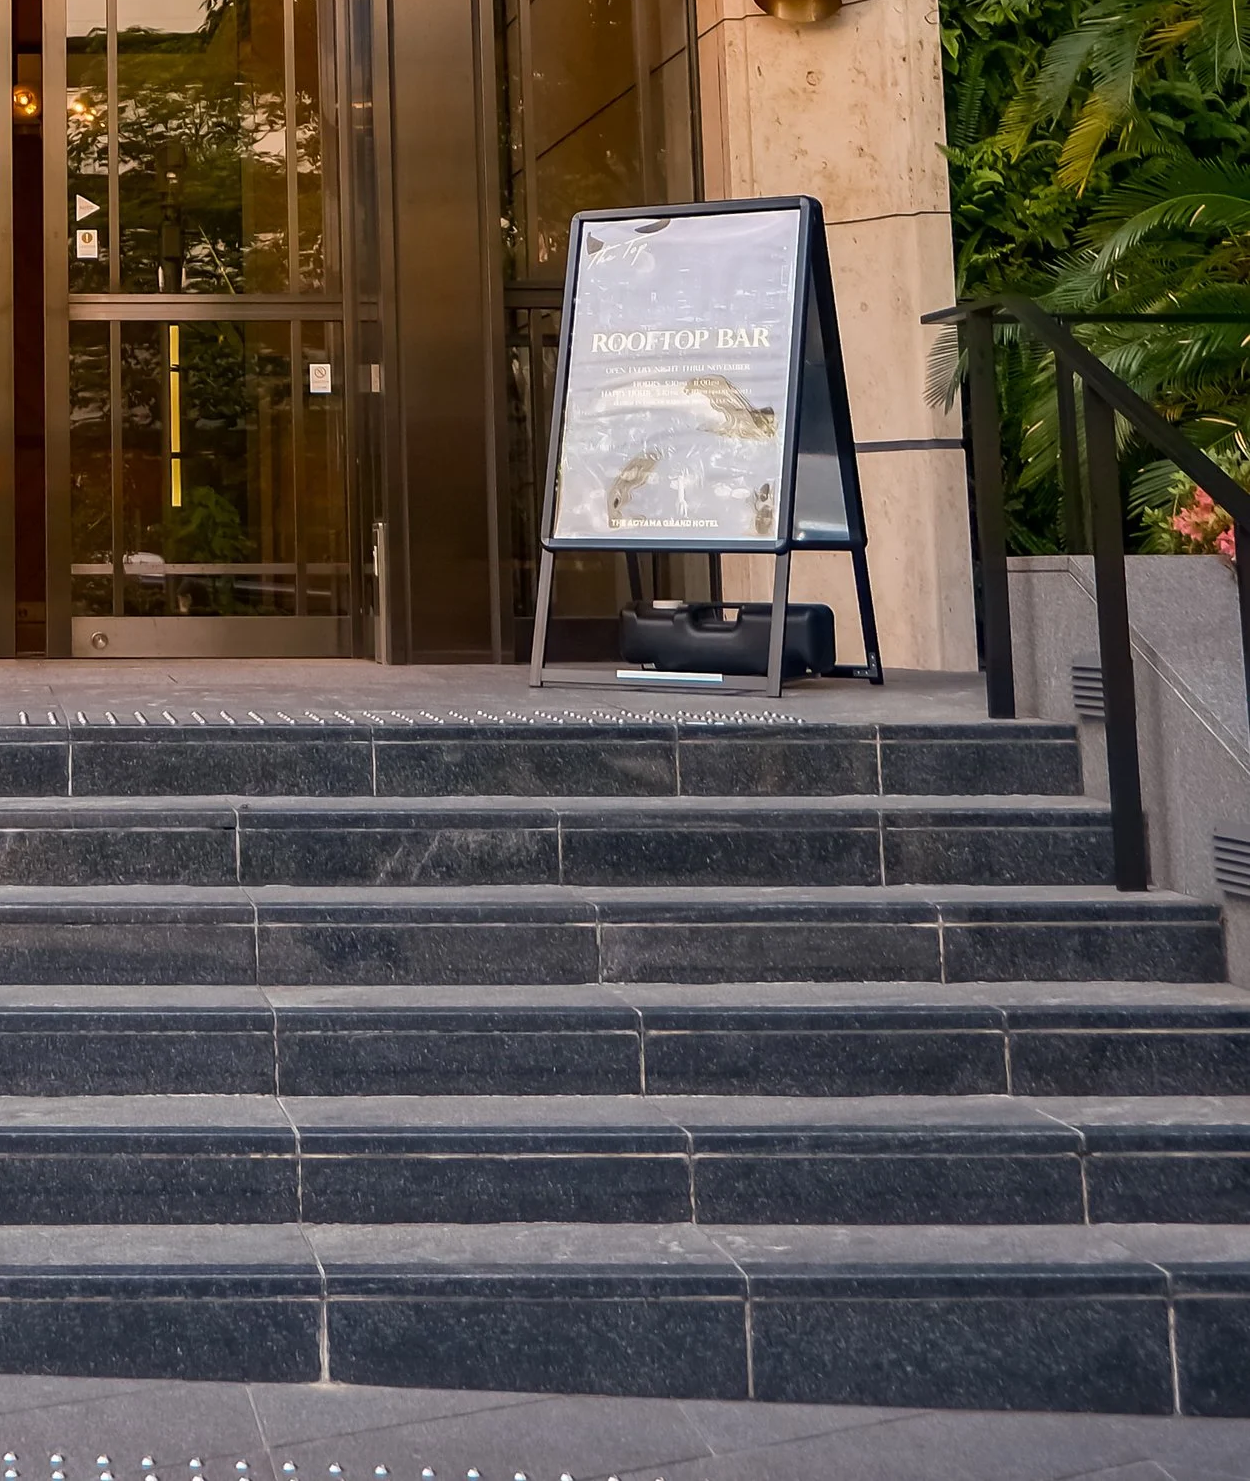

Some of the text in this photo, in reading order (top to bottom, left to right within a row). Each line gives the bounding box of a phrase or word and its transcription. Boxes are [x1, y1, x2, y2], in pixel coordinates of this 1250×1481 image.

[588, 244, 621, 270] The
[591, 327, 771, 353] ROOFTOP BAR
[707, 363, 751, 372] NOVEMBER
[611, 518, 719, 527] THE AOYAMA GRAND HOTEL
